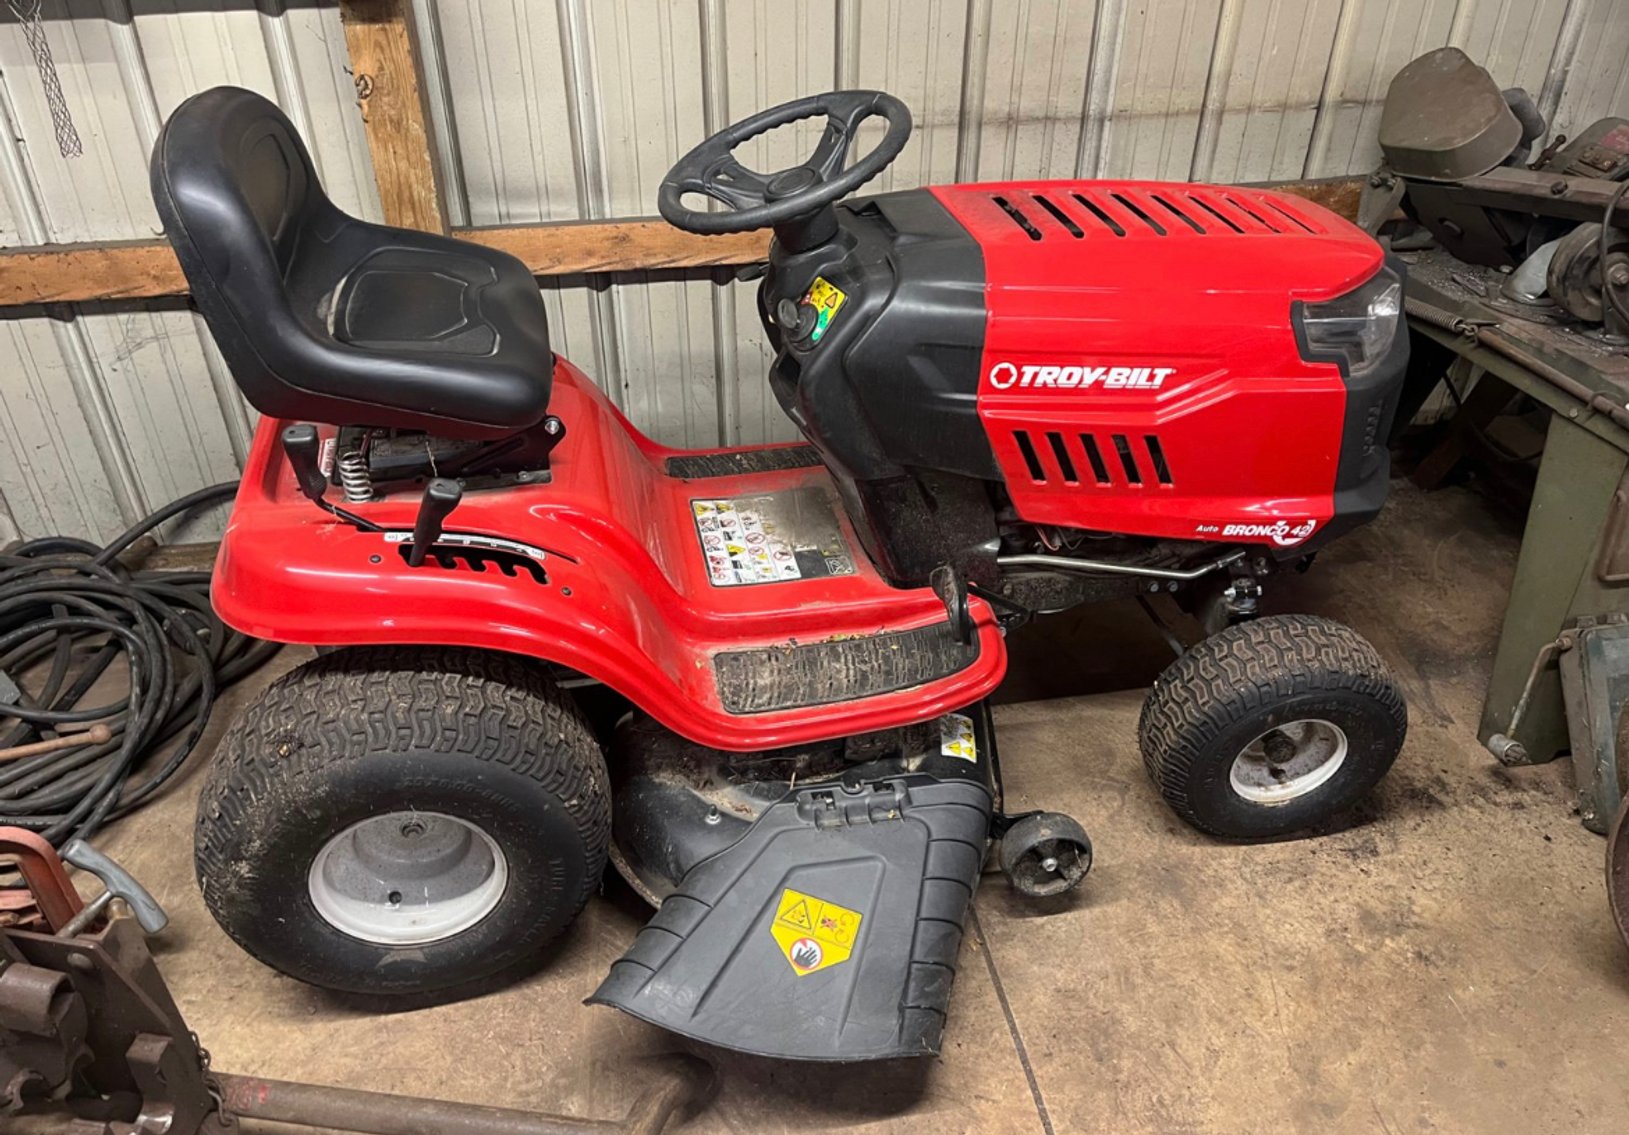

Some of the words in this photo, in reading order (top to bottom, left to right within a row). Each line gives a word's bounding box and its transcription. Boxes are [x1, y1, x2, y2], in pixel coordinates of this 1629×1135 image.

[1019, 365, 1173, 389] TROY-BILT
[1196, 525, 1219, 533] Auto
[1222, 524, 1290, 536] BRONCO
